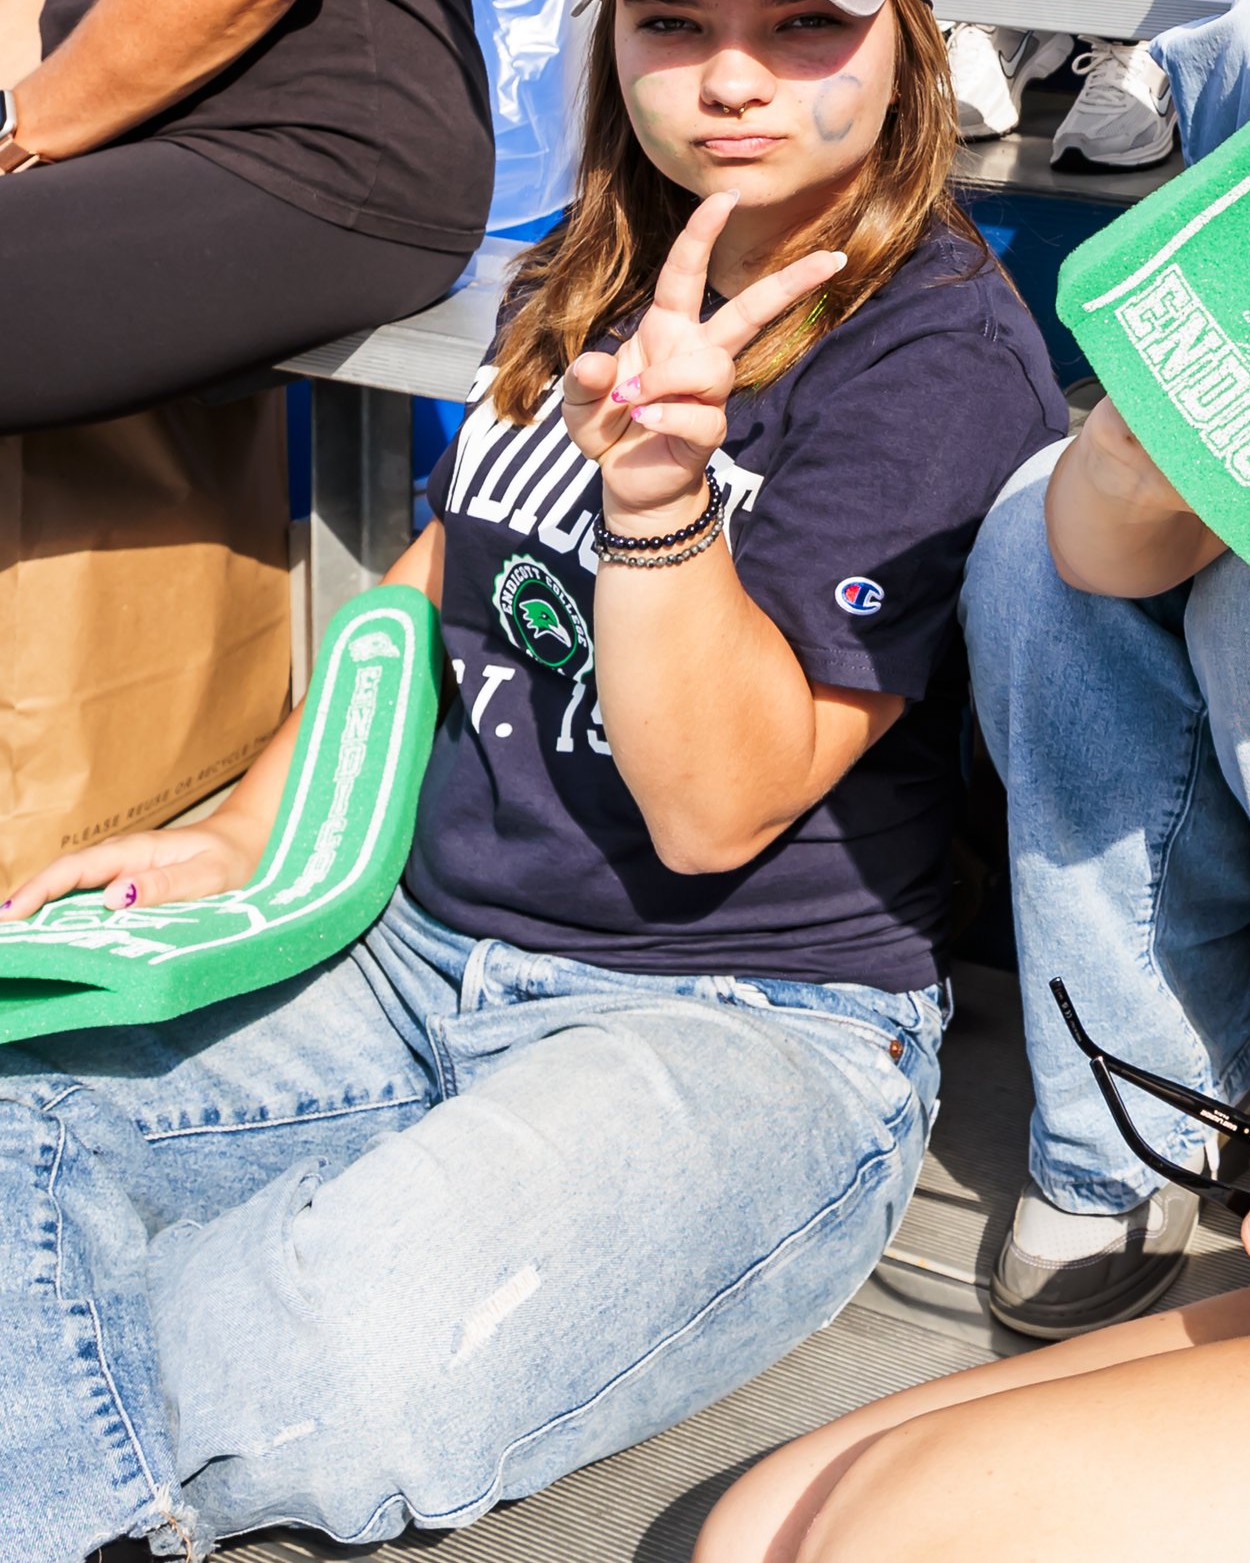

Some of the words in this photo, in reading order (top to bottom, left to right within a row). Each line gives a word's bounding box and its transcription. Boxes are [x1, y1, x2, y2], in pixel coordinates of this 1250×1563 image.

[500, 564, 542, 617] ENDICOTT
[60, 815, 122, 850] PLEASE
[126, 791, 170, 819] REUSE
[174, 775, 193, 797] OR
[196, 746, 249, 781] RECYCLE
